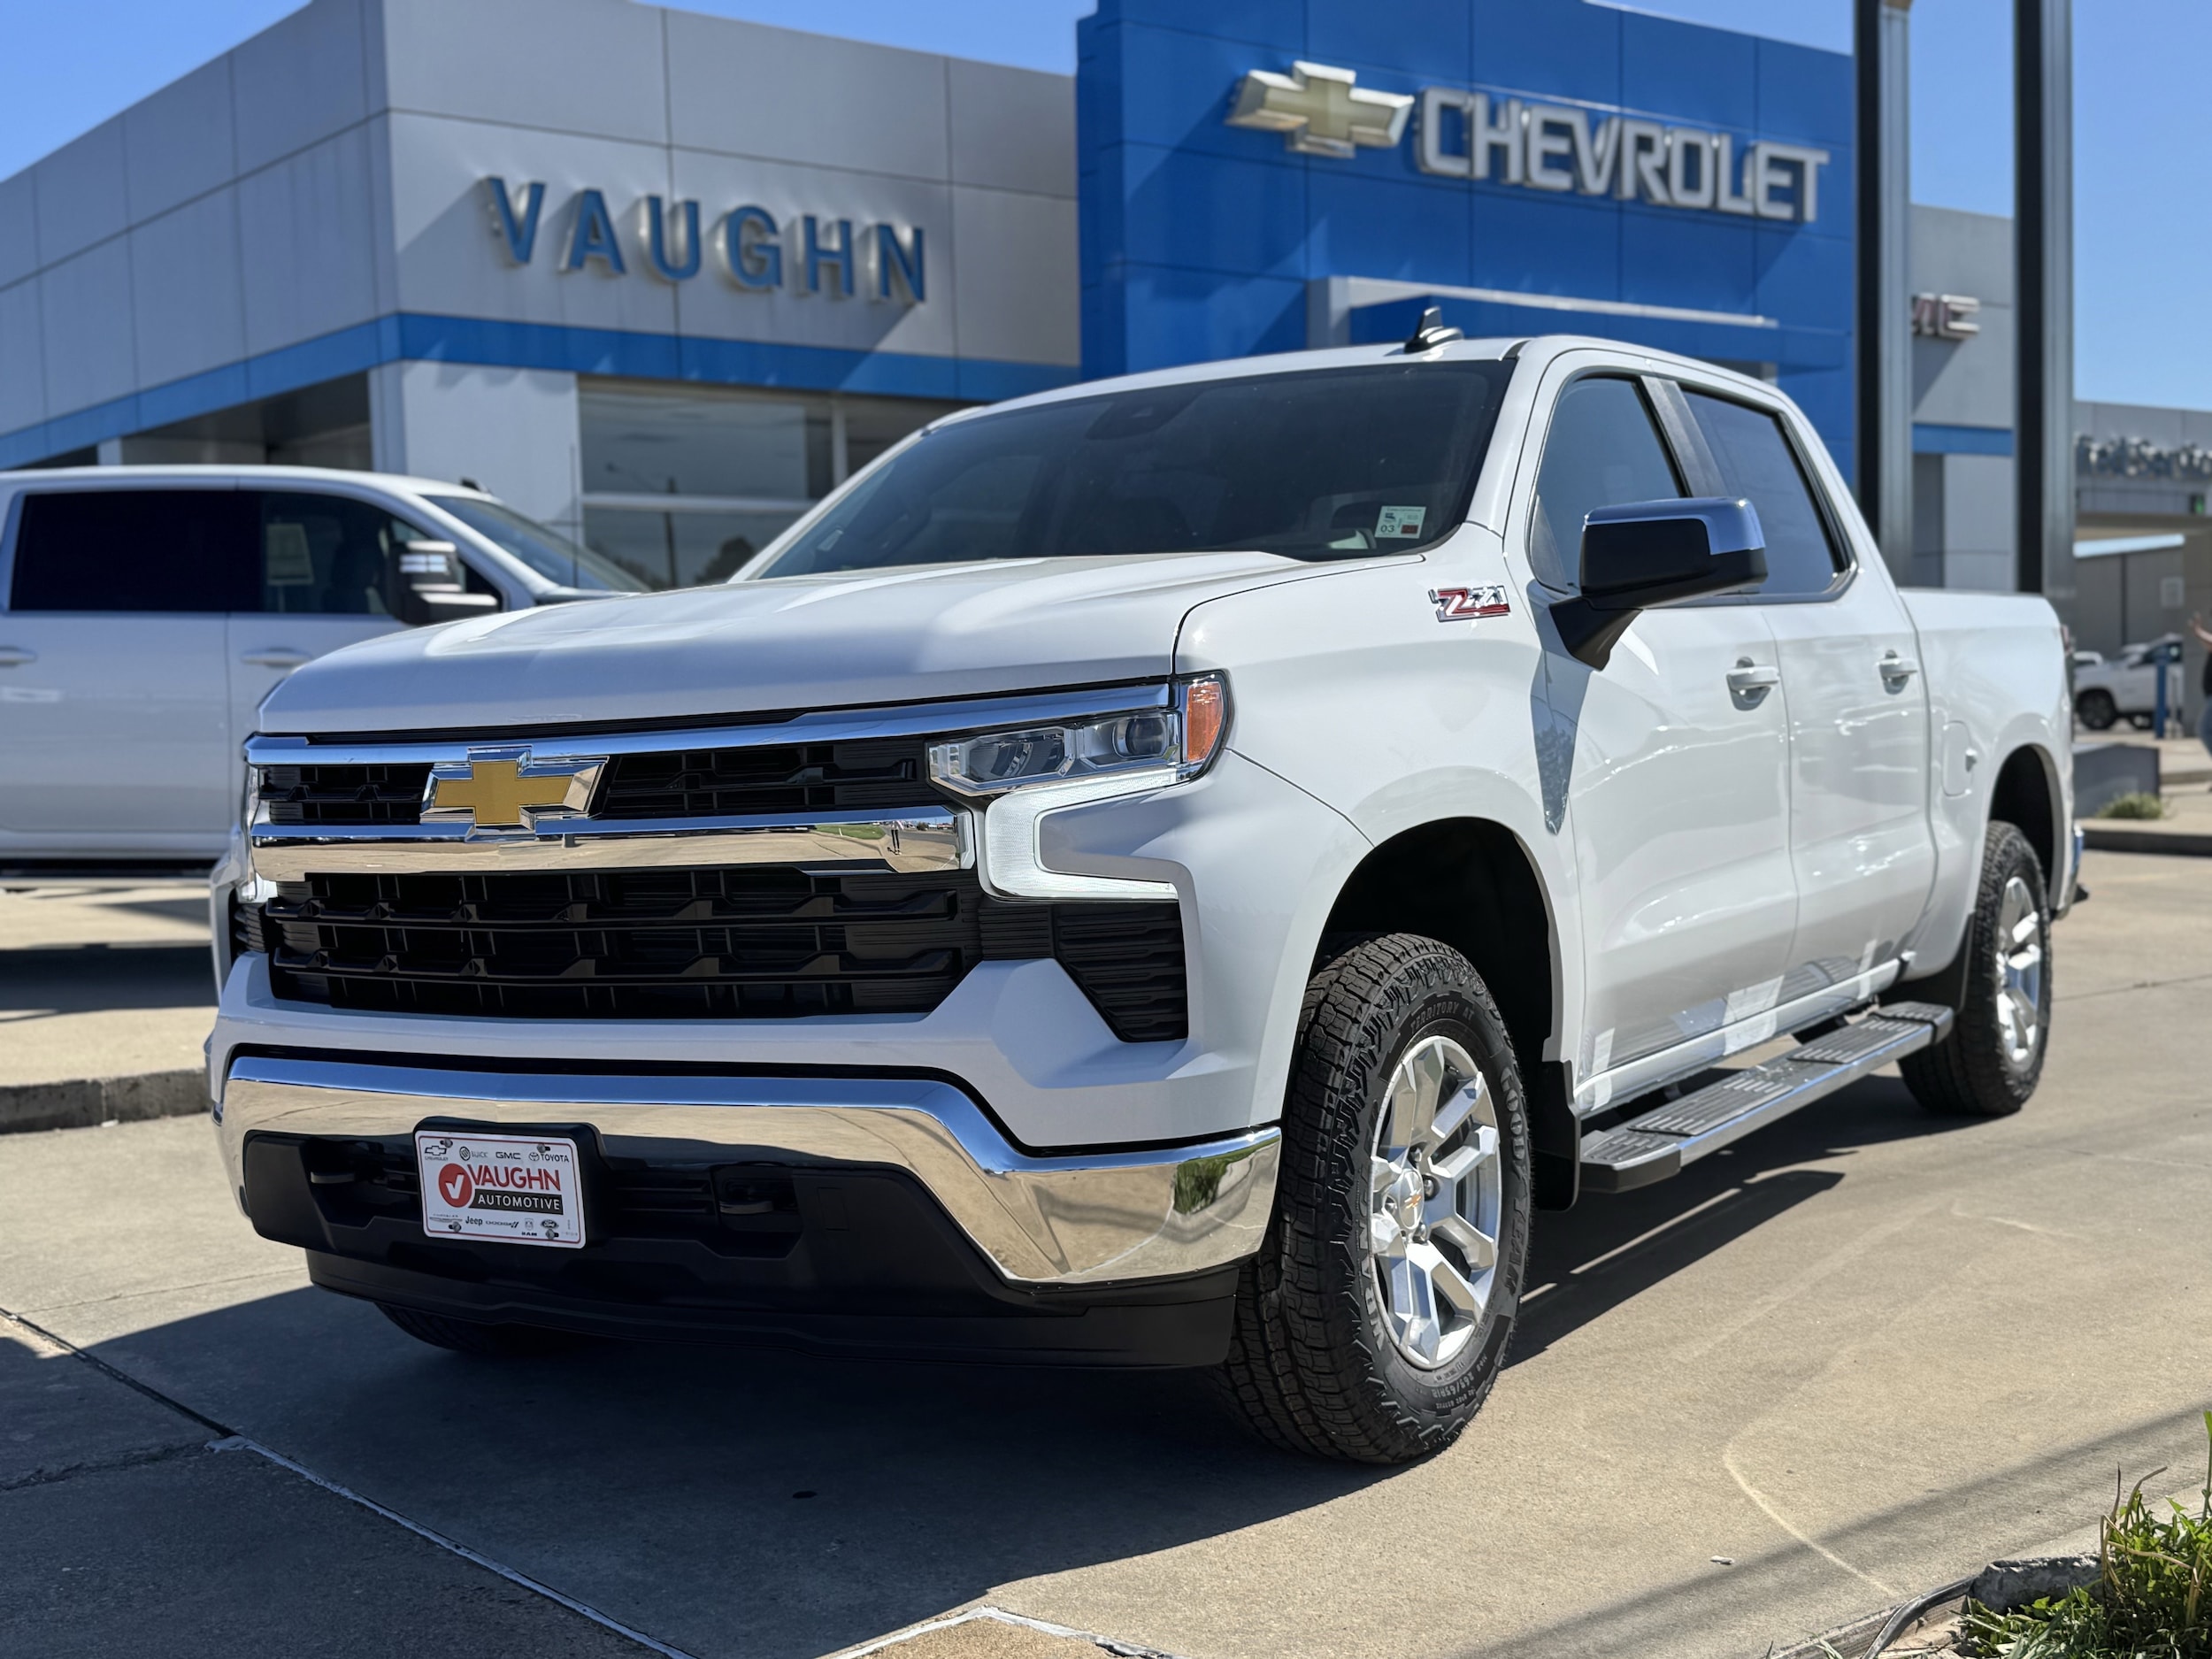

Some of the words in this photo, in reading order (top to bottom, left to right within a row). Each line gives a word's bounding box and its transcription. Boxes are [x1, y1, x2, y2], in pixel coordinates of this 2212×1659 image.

[1419, 87, 1830, 223] CHEVROLET
[484, 175, 926, 303] VAUGHN
[1428, 584, 1510, 622] Z71
[1409, 1001, 1460, 1034] TERRITORY
[1462, 1006, 1475, 1021] AT
[495, 1151, 522, 1160] GMC
[541, 1153, 570, 1163] TOYOTA
[467, 1164, 561, 1191] VAUGHN
[1500, 1066, 1528, 1296] GOODYEAR
[477, 1194, 561, 1210] AUTOMOTIVE
[465, 1216, 483, 1226] Jeep
